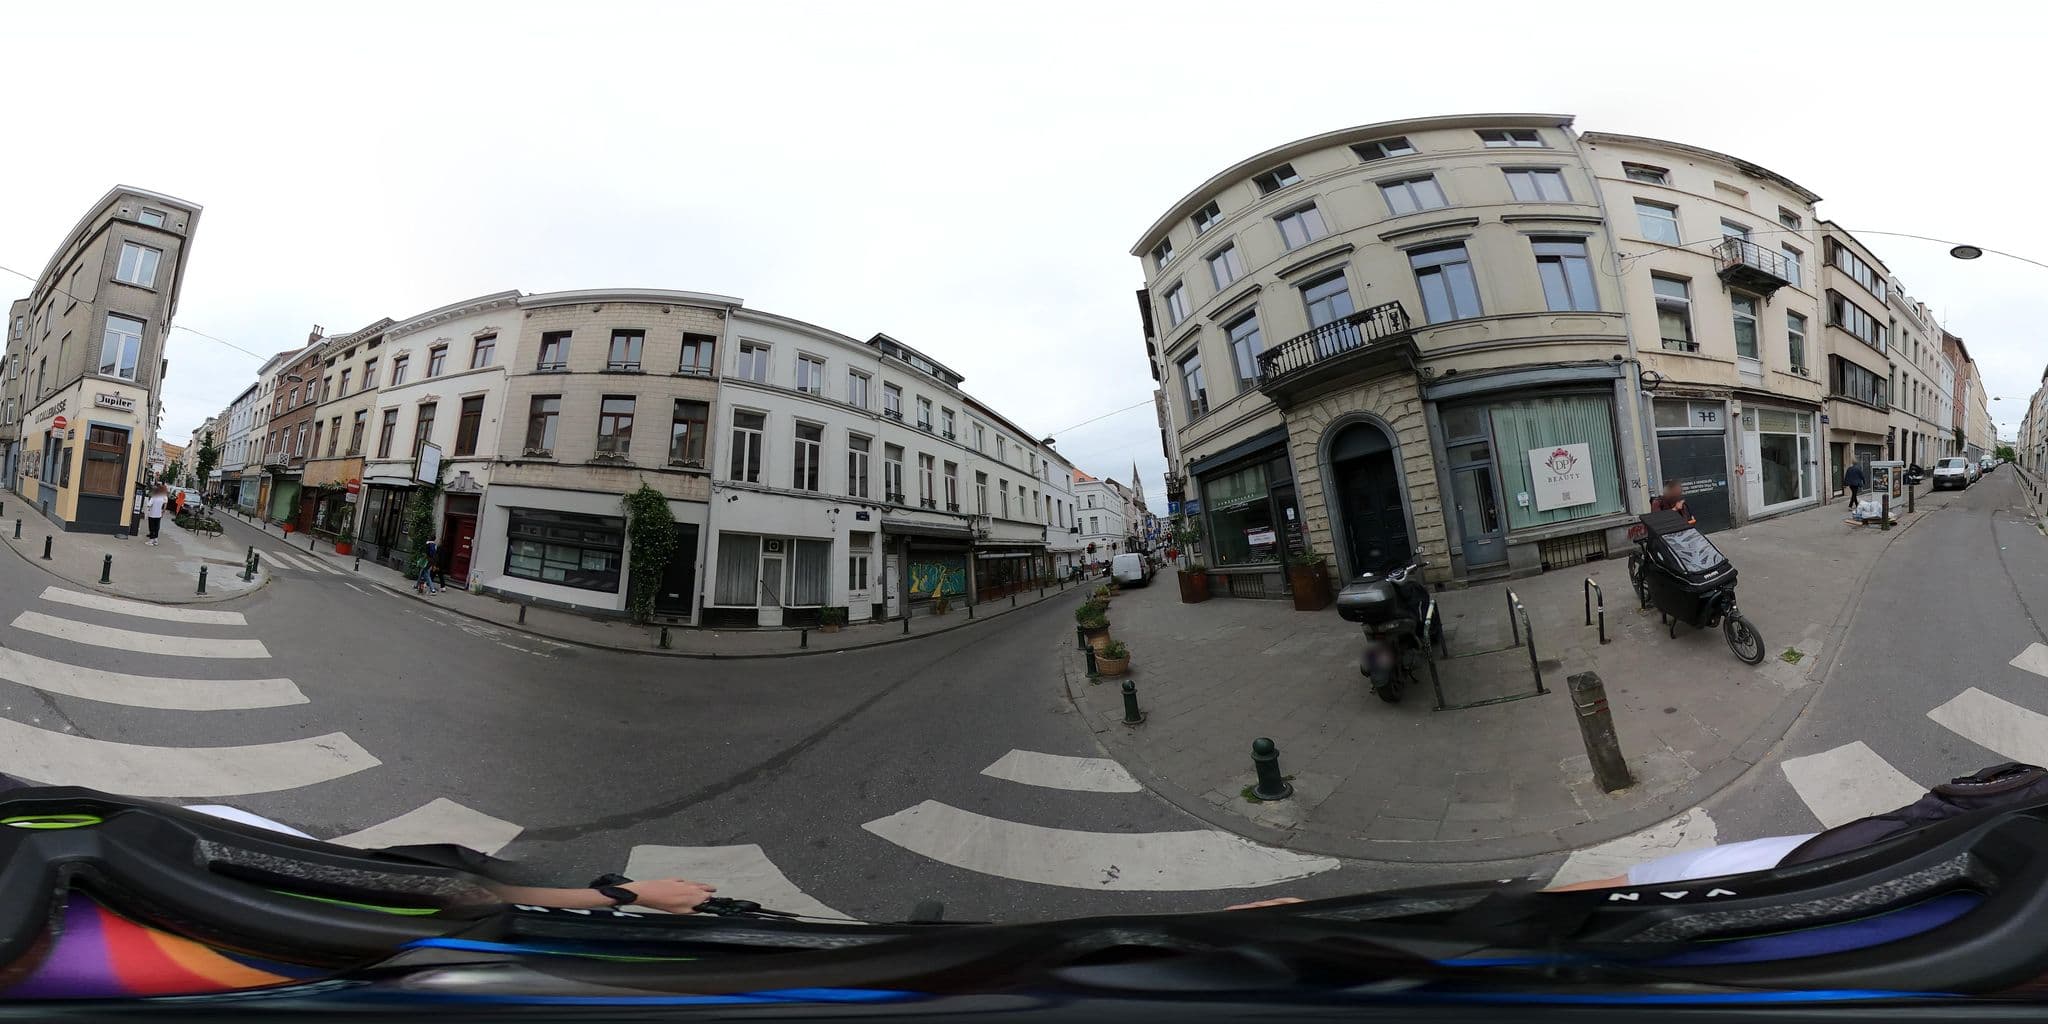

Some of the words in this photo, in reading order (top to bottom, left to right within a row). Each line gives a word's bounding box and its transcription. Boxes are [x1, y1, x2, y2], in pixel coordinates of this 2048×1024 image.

[99, 396, 132, 408] Jupiler
[1555, 459, 1569, 471] DP
[1547, 472, 1581, 483] BEAUTY
